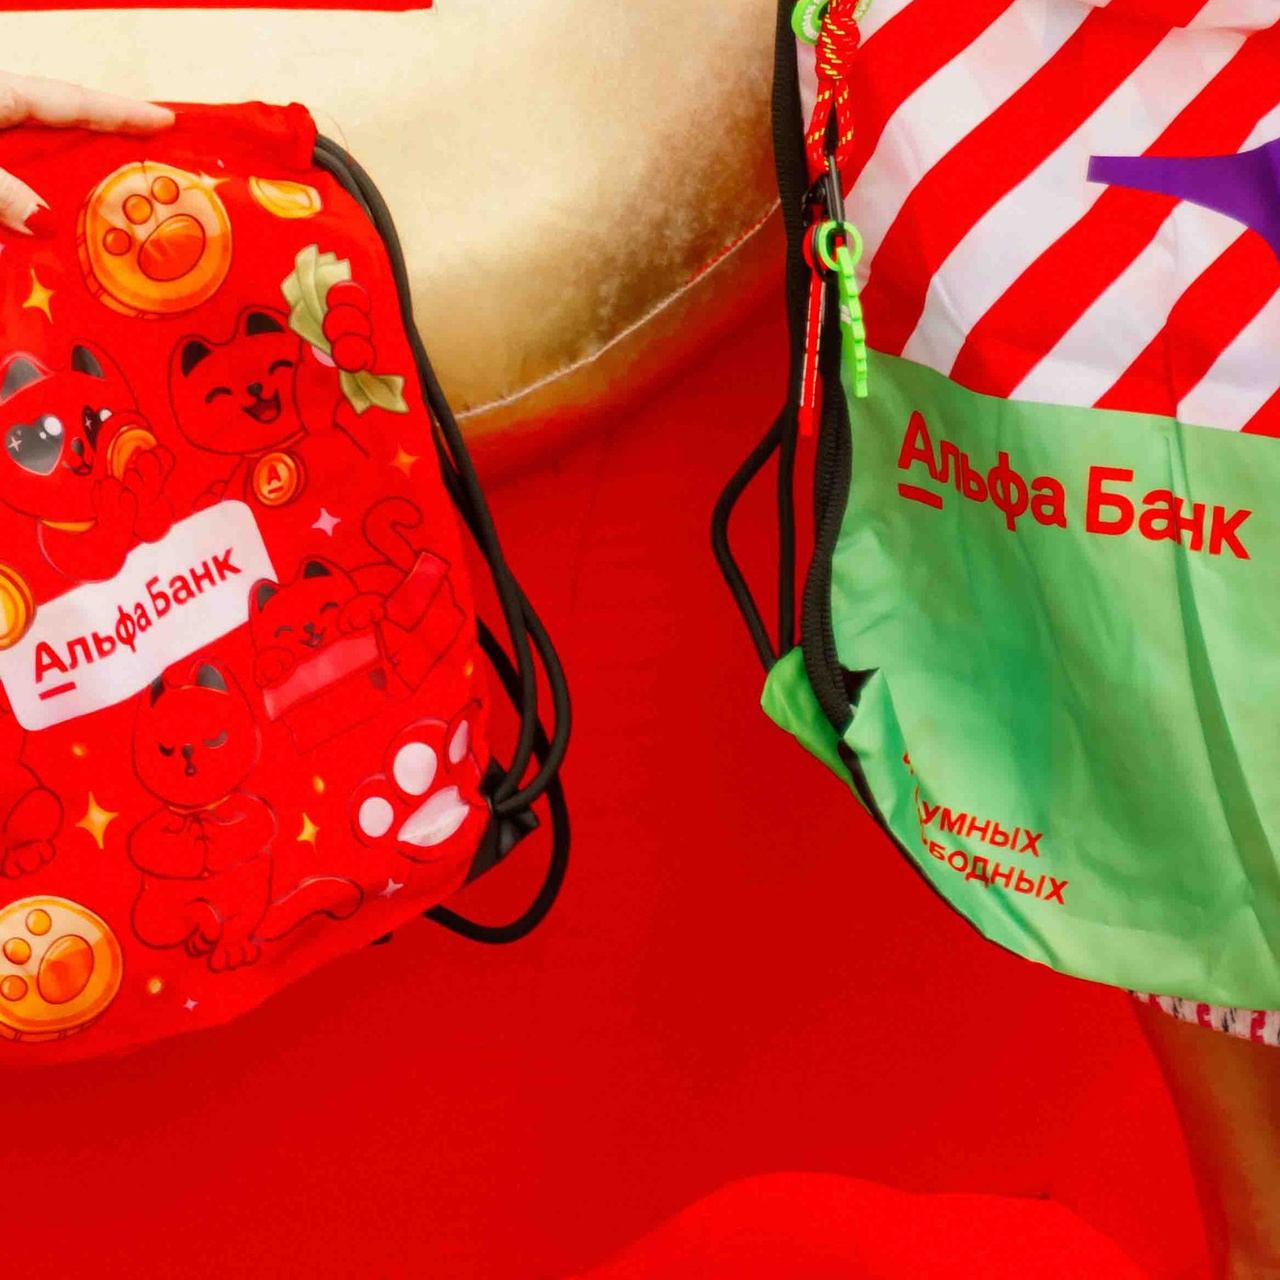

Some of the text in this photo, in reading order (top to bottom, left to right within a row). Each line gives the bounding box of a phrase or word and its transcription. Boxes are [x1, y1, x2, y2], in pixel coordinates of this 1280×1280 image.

[898, 411, 1252, 560] Альфа Банк
[35, 547, 242, 685] Альфа Банк
[922, 800, 1043, 858] УМНЫХ
[923, 838, 1069, 906] БОДНЫХ
